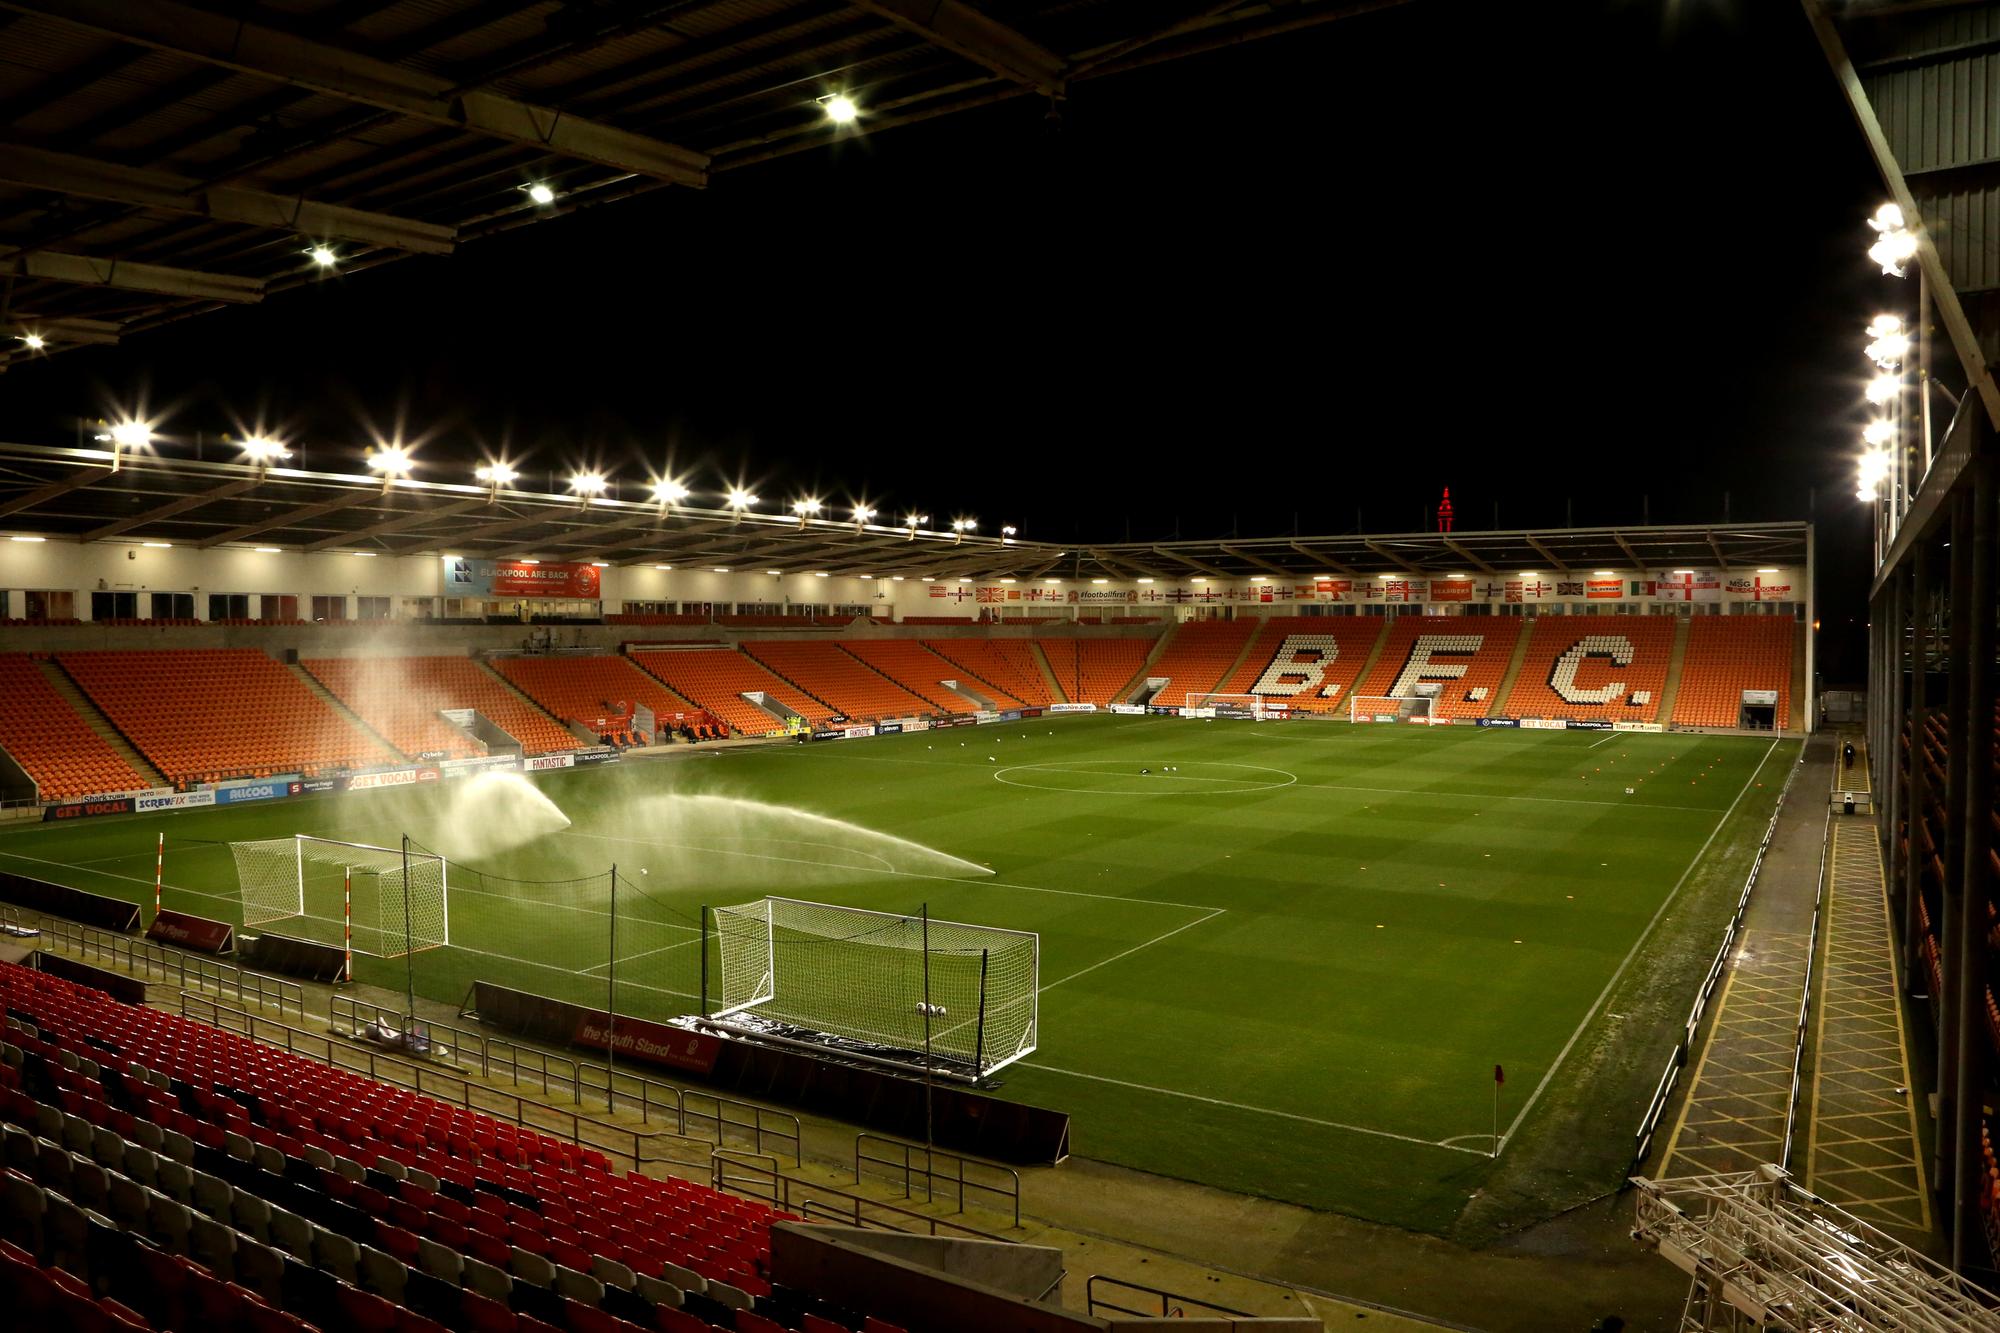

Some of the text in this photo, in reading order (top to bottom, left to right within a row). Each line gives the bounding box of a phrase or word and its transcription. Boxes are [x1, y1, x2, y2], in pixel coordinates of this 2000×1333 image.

[480, 568, 569, 579] BLACKPOOL ARE BACK
[1729, 580, 1750, 588] MSG
[1081, 591, 1126, 599] #footballfirst
[1539, 721, 1566, 729] VOCAL
[533, 757, 566, 770] FANTASTIC
[355, 775, 377, 788] GET
[380, 771, 416, 785] VOCAL
[84, 794, 107, 804] Shark
[139, 796, 186, 808] SCREWFIX
[56, 800, 128, 819] GET VOCAL
[582, 1025, 672, 1057] the South Stand
